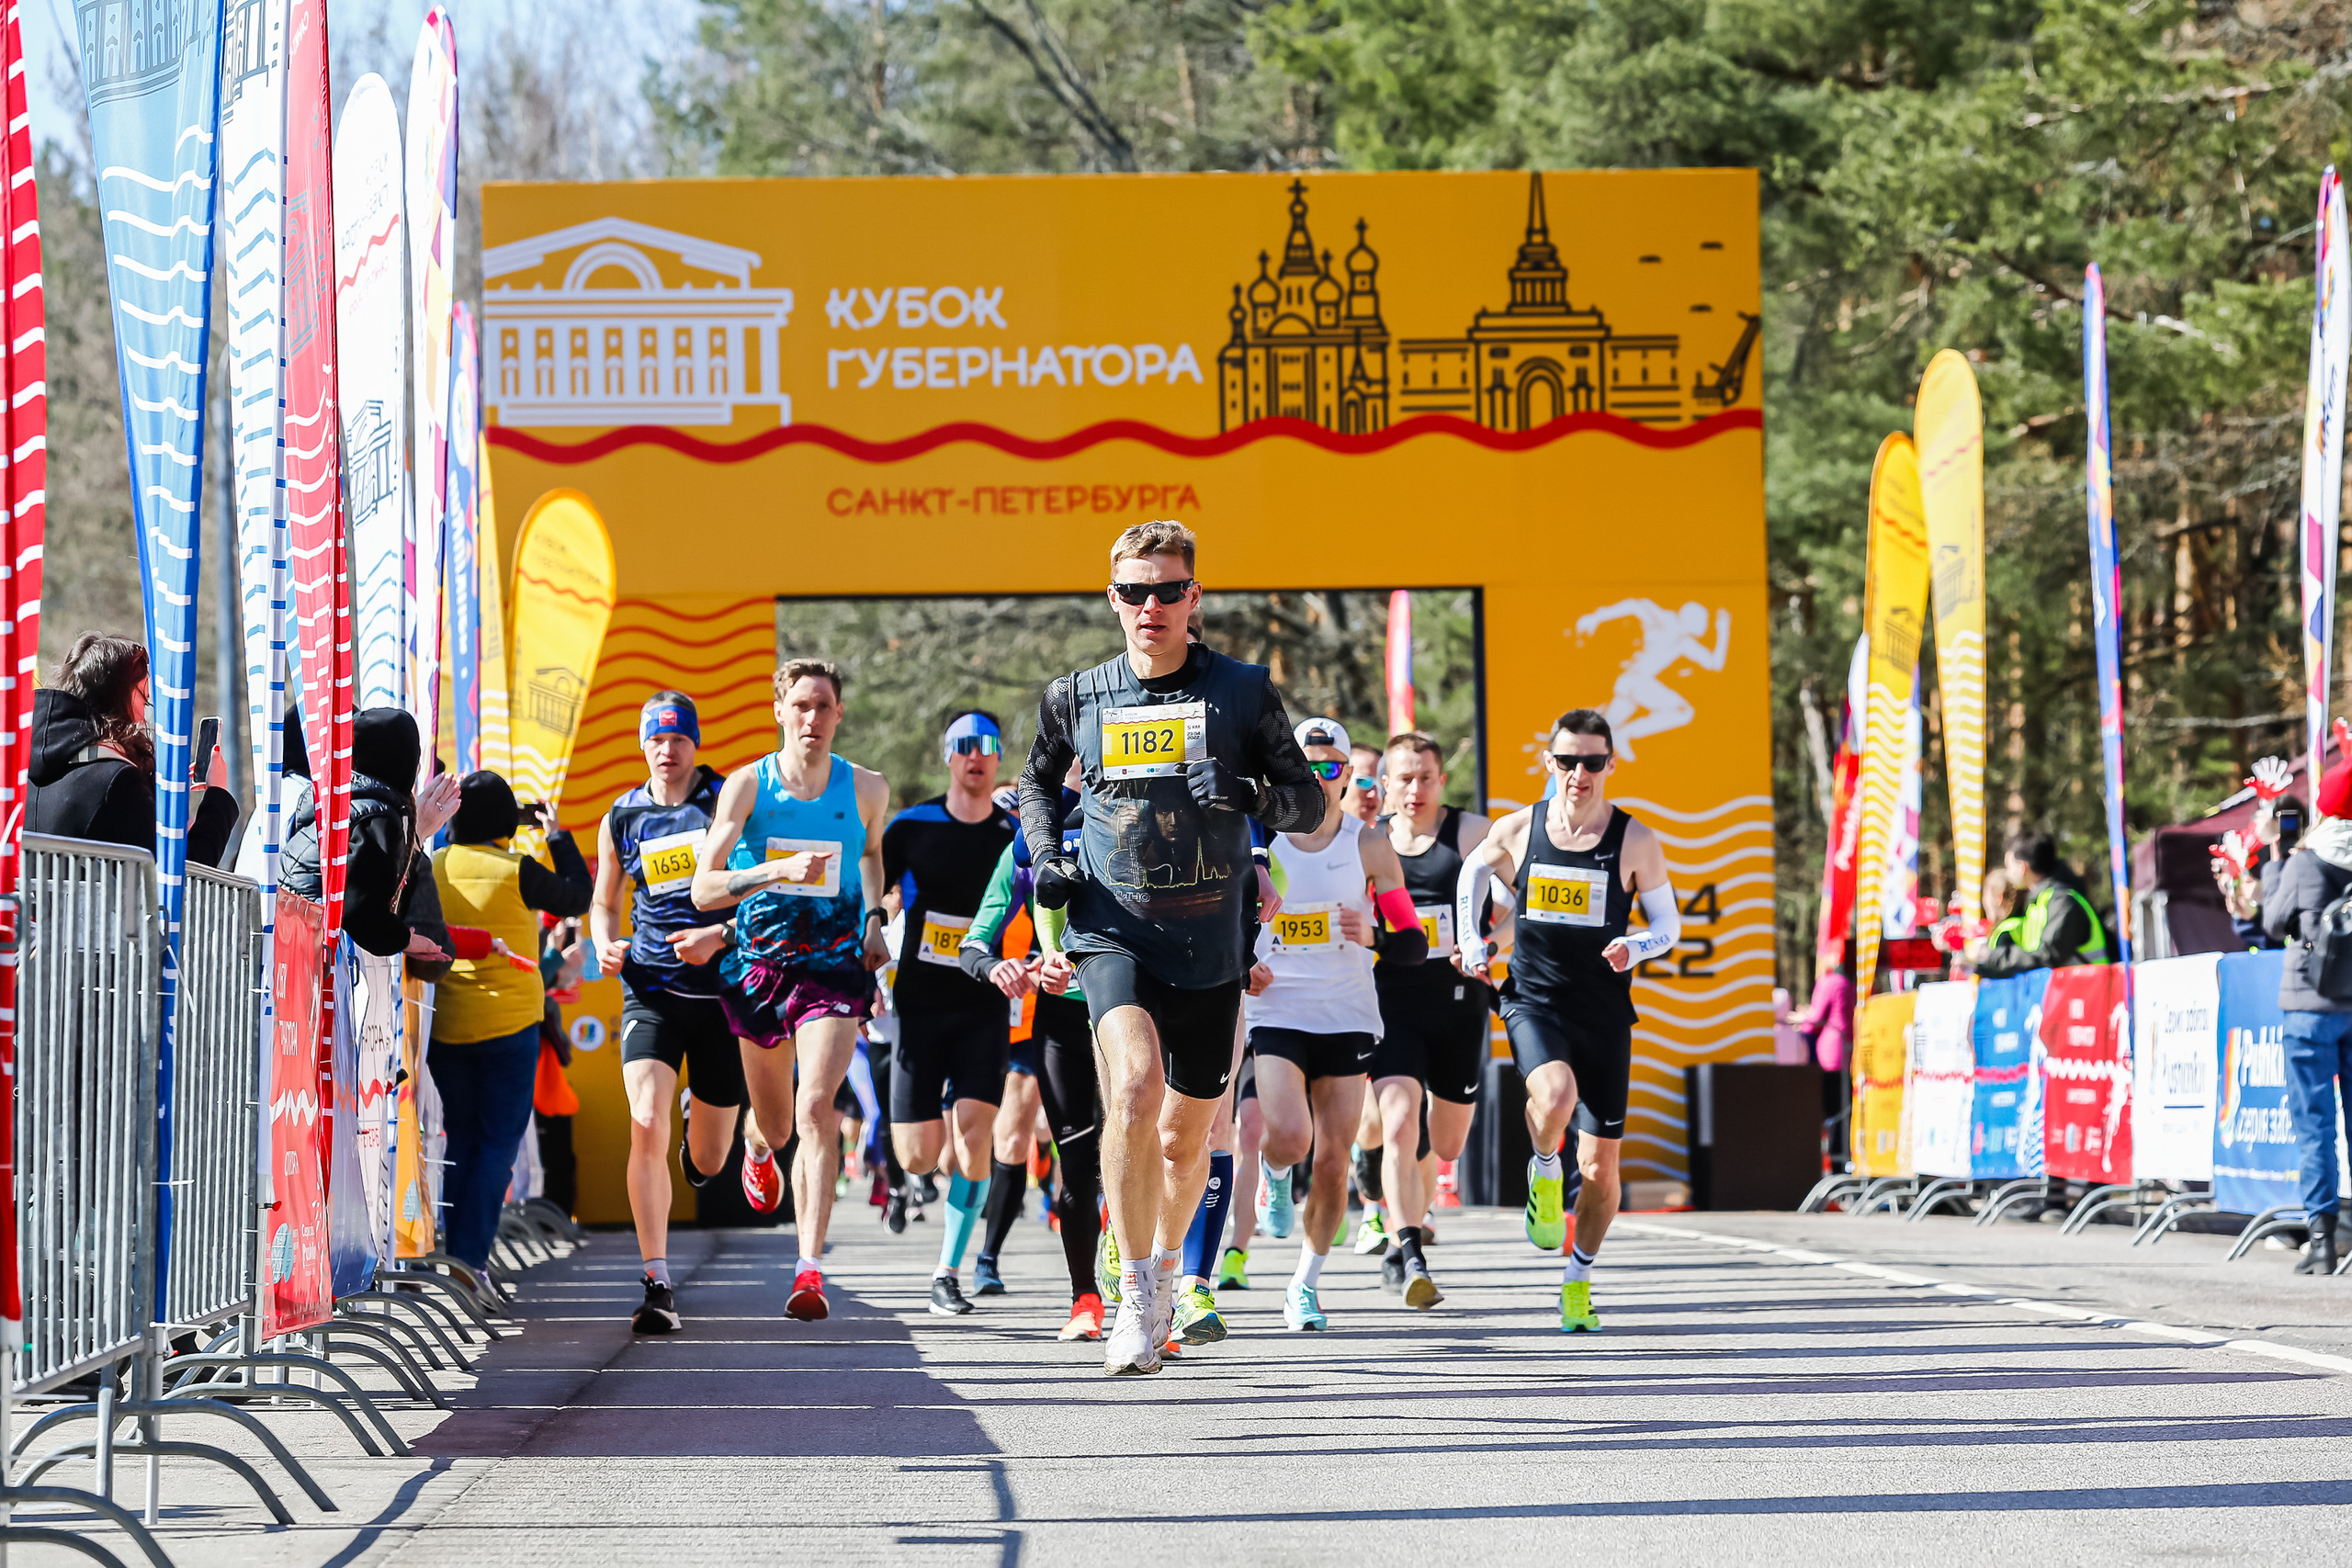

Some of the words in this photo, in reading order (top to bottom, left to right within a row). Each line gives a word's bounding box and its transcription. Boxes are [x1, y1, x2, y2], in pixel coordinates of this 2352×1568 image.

[825, 286, 1008, 330] КУБОК
[827, 343, 1204, 389] ГУБЕРНАТОРА
[827, 484, 1202, 517] САНКТ-ПЕТЕРБУРГА
[1121, 728, 1174, 754] 1182
[652, 852, 691, 875] 1653
[1541, 886, 1583, 906] 1036
[934, 931, 962, 950] 187
[1272, 936, 1281, 945] A
[1281, 919, 1323, 938] 1953
[1638, 938, 1715, 978] 22
